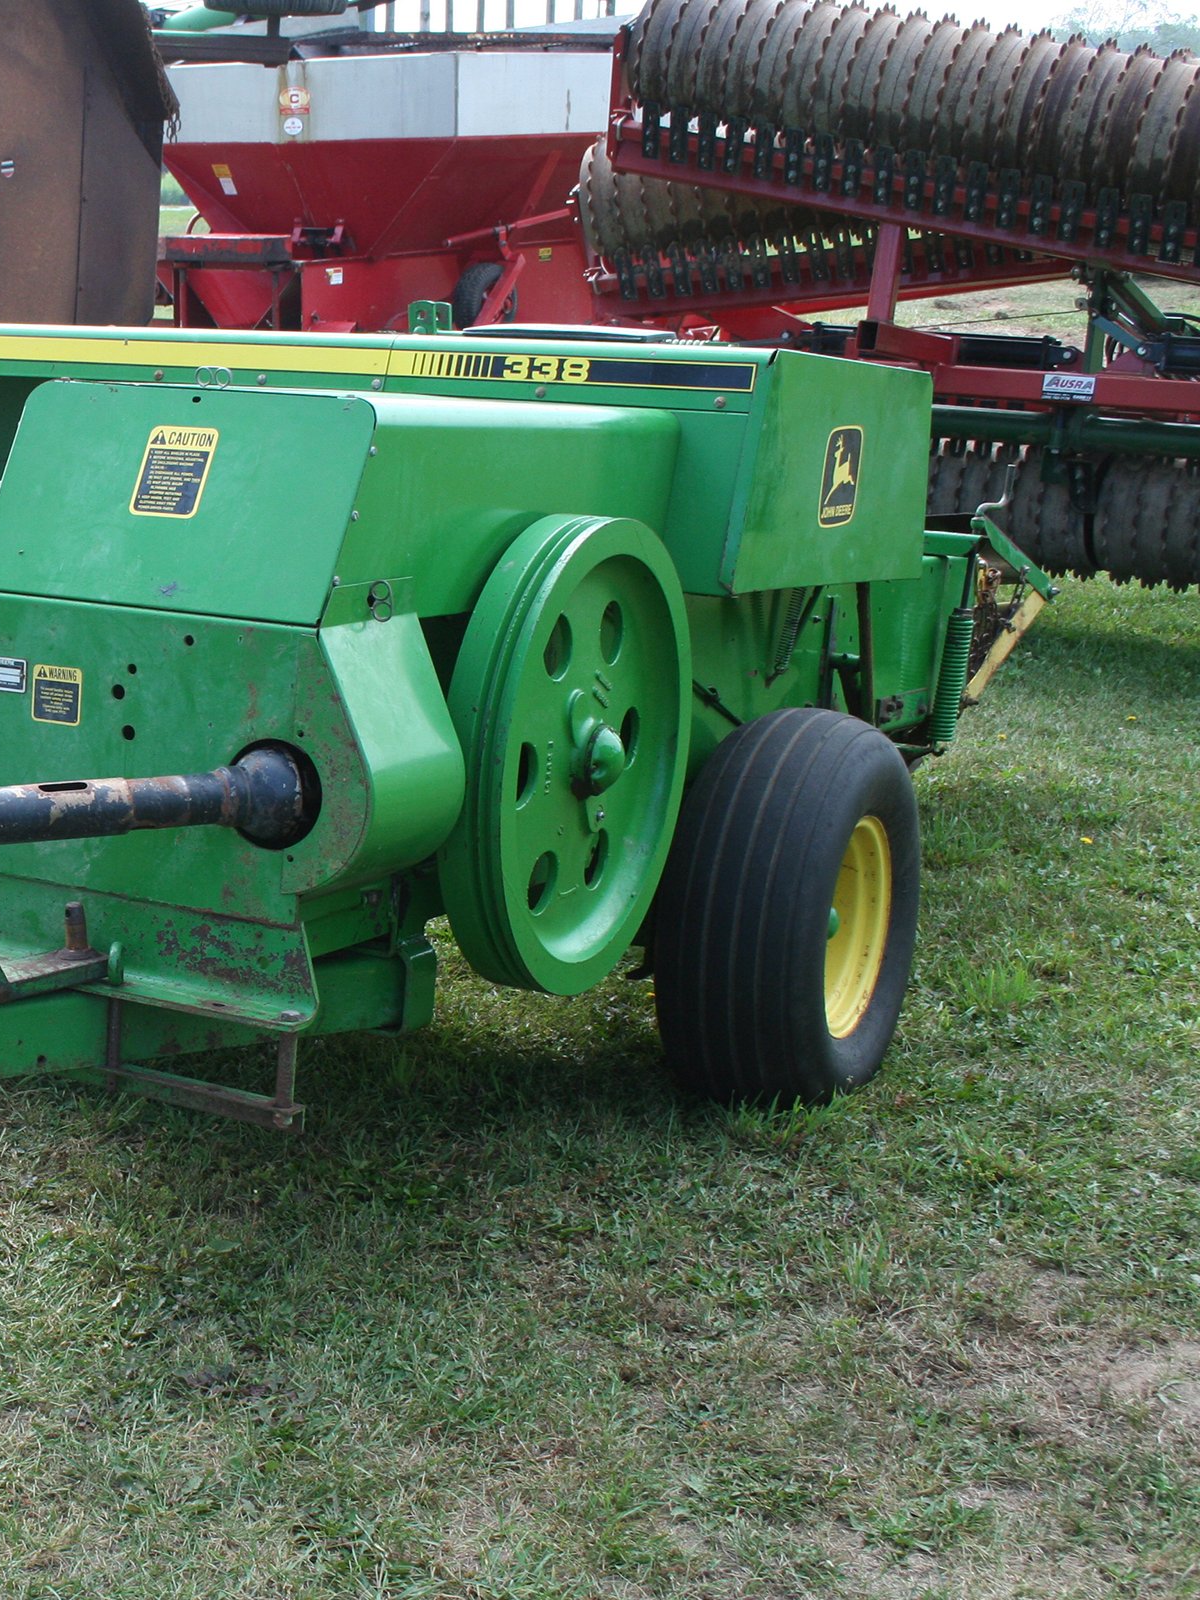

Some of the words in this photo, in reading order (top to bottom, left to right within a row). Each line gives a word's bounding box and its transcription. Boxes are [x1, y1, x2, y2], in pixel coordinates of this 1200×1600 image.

[502, 356, 590, 382] 338
[1045, 376, 1093, 390] AUSRA
[168, 432, 214, 447] CAUTION
[821, 506, 835, 519] JOHN
[835, 504, 852, 517] DEERE
[48, 668, 77, 681] WARNING
